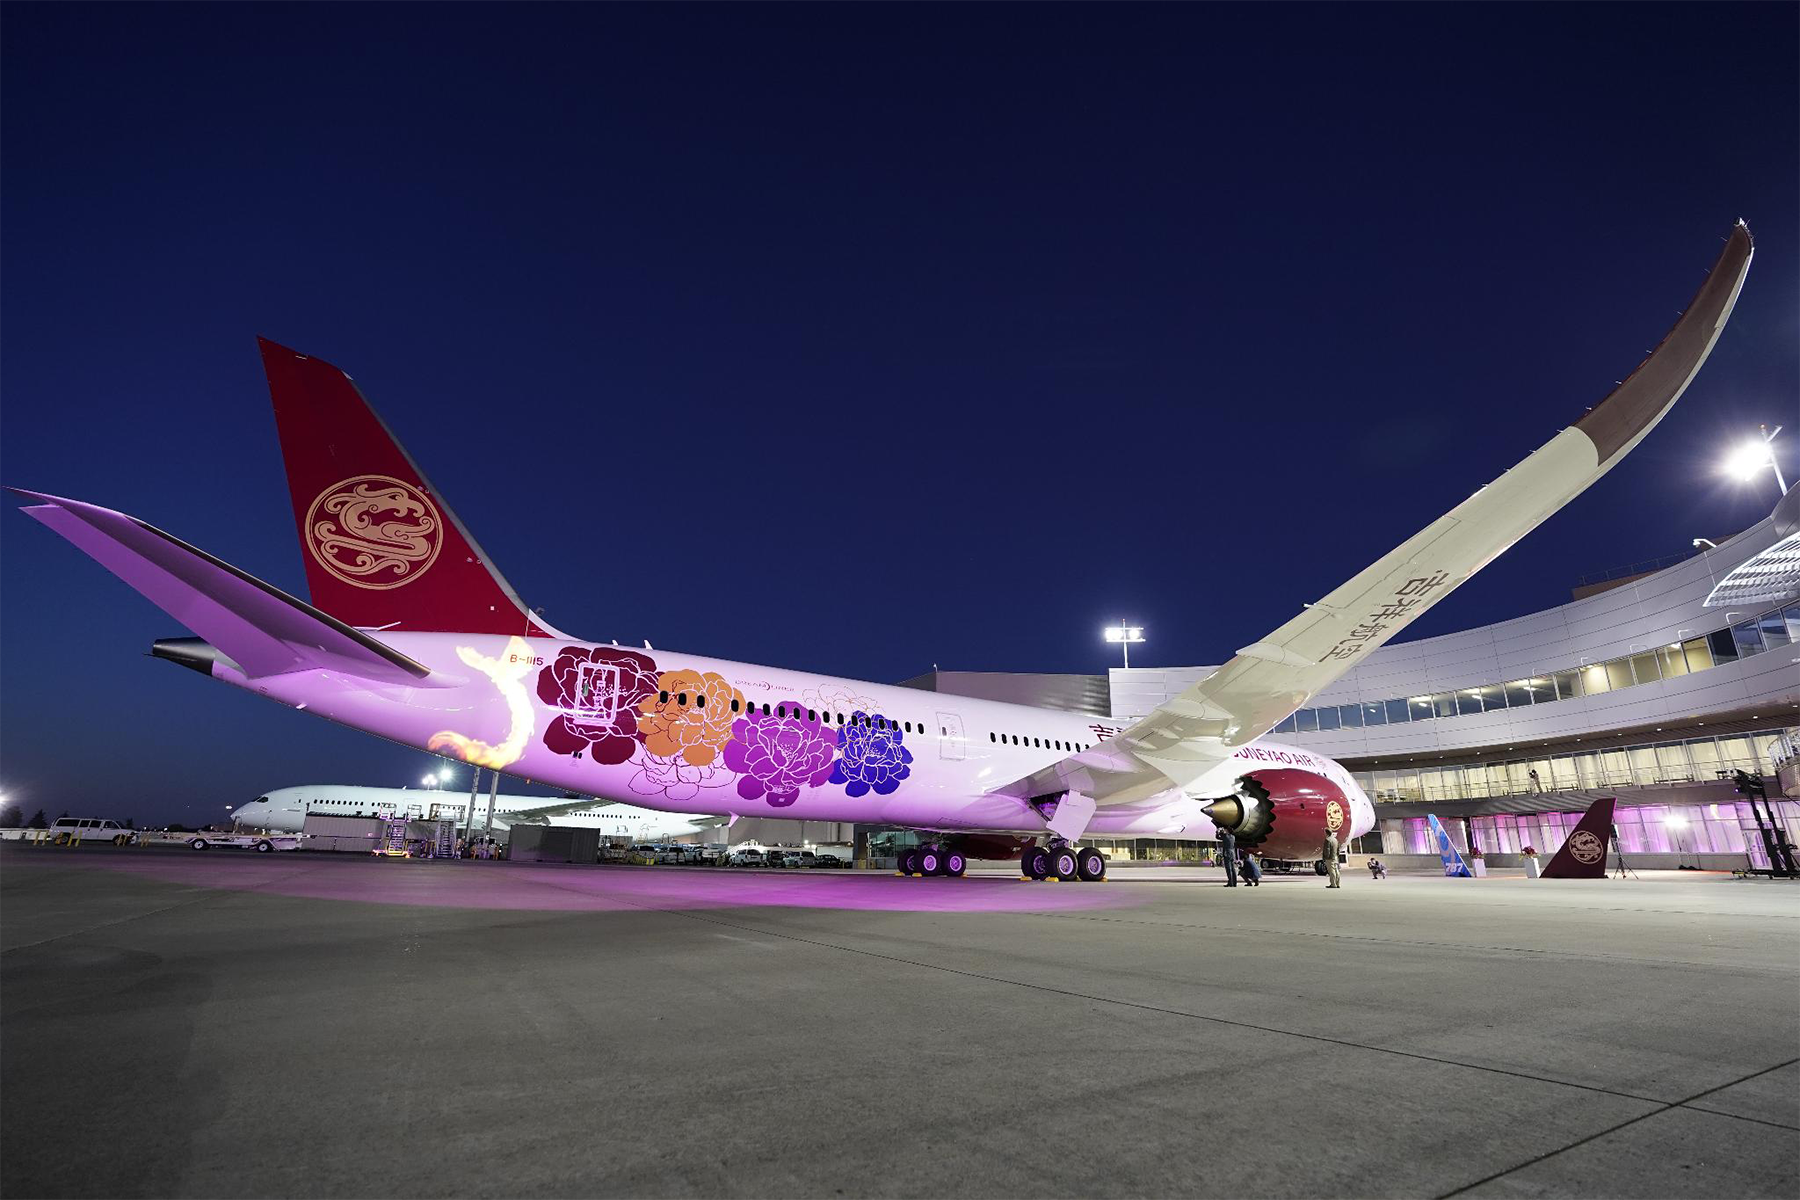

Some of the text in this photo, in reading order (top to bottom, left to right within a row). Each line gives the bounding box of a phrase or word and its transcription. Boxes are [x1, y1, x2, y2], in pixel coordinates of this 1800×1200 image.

[1318, 569, 1450, 663] 吉祥航空
[509, 654, 544, 666] B-1115
[1292, 753, 1316, 767] AIR
[1445, 862, 1464, 873] 787
